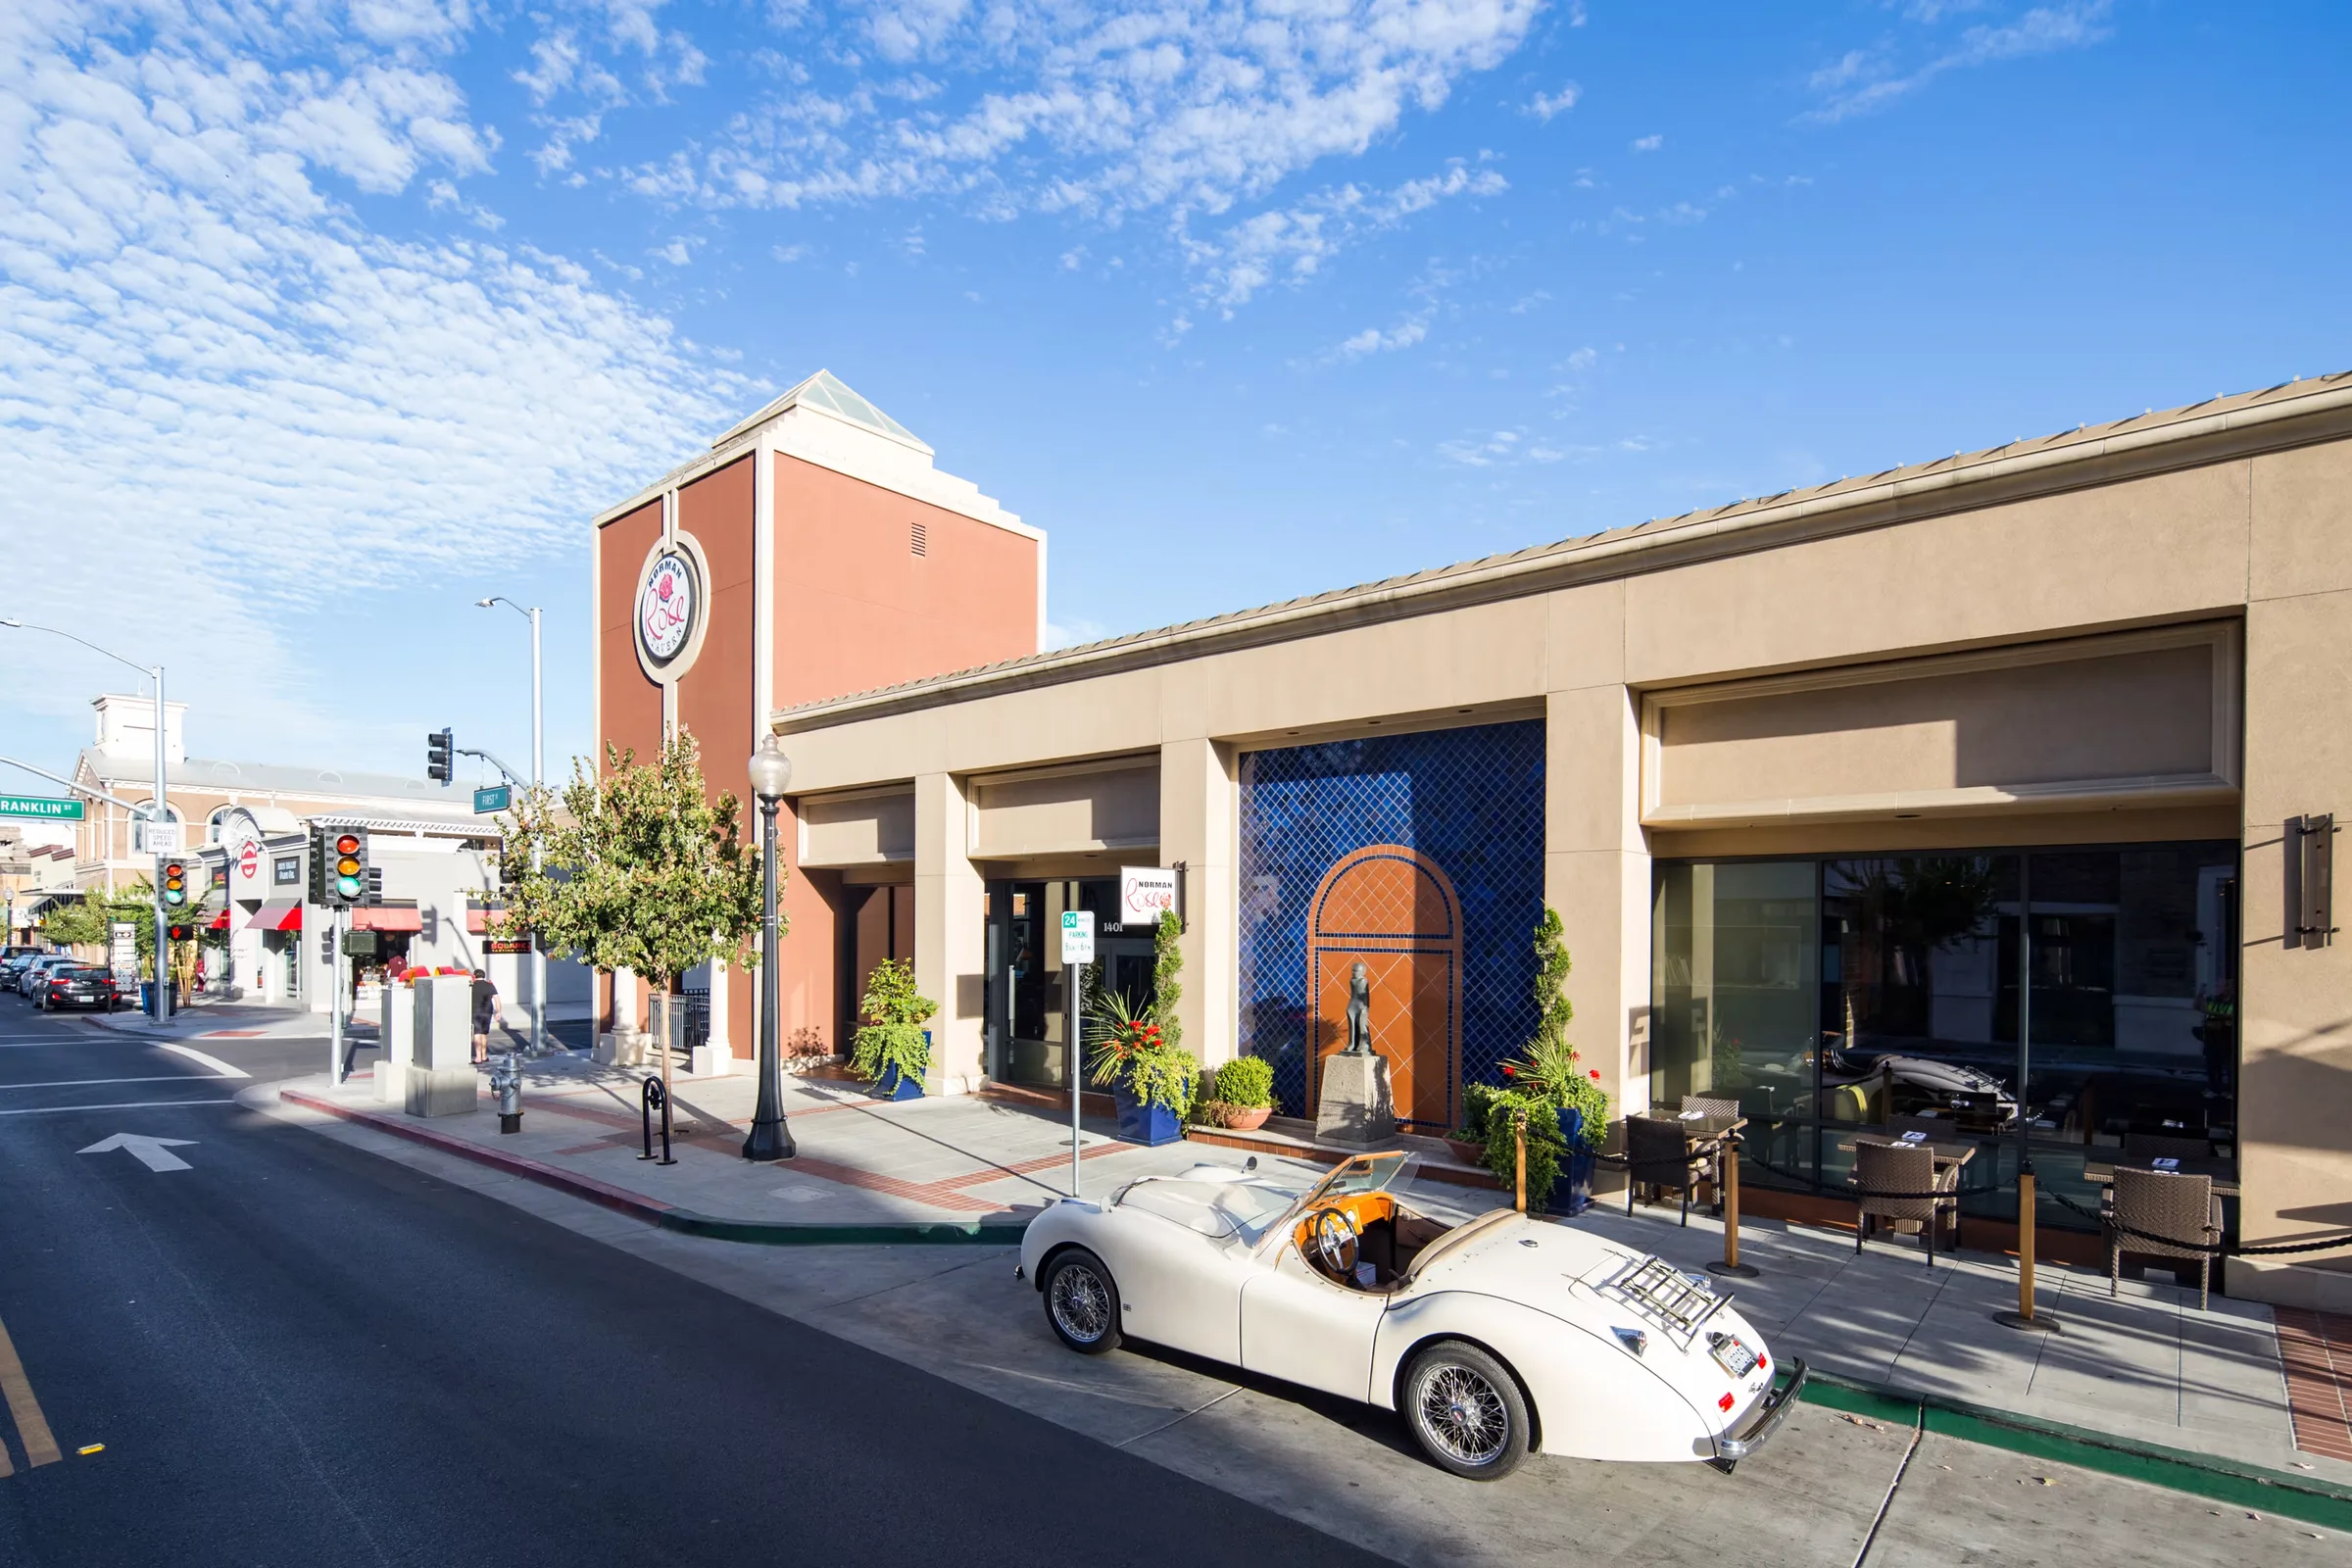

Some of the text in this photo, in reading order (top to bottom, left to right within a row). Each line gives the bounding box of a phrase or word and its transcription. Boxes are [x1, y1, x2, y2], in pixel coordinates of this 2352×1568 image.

[648, 561, 682, 587] NORMAN
[651, 627, 682, 653] TAVERN
[482, 794, 495, 806] FIRST
[0, 800, 62, 814] RANKLIN
[1138, 880, 1173, 889] NORMAN
[1064, 914, 1076, 926] 24
[1102, 921, 1123, 933] 1401
